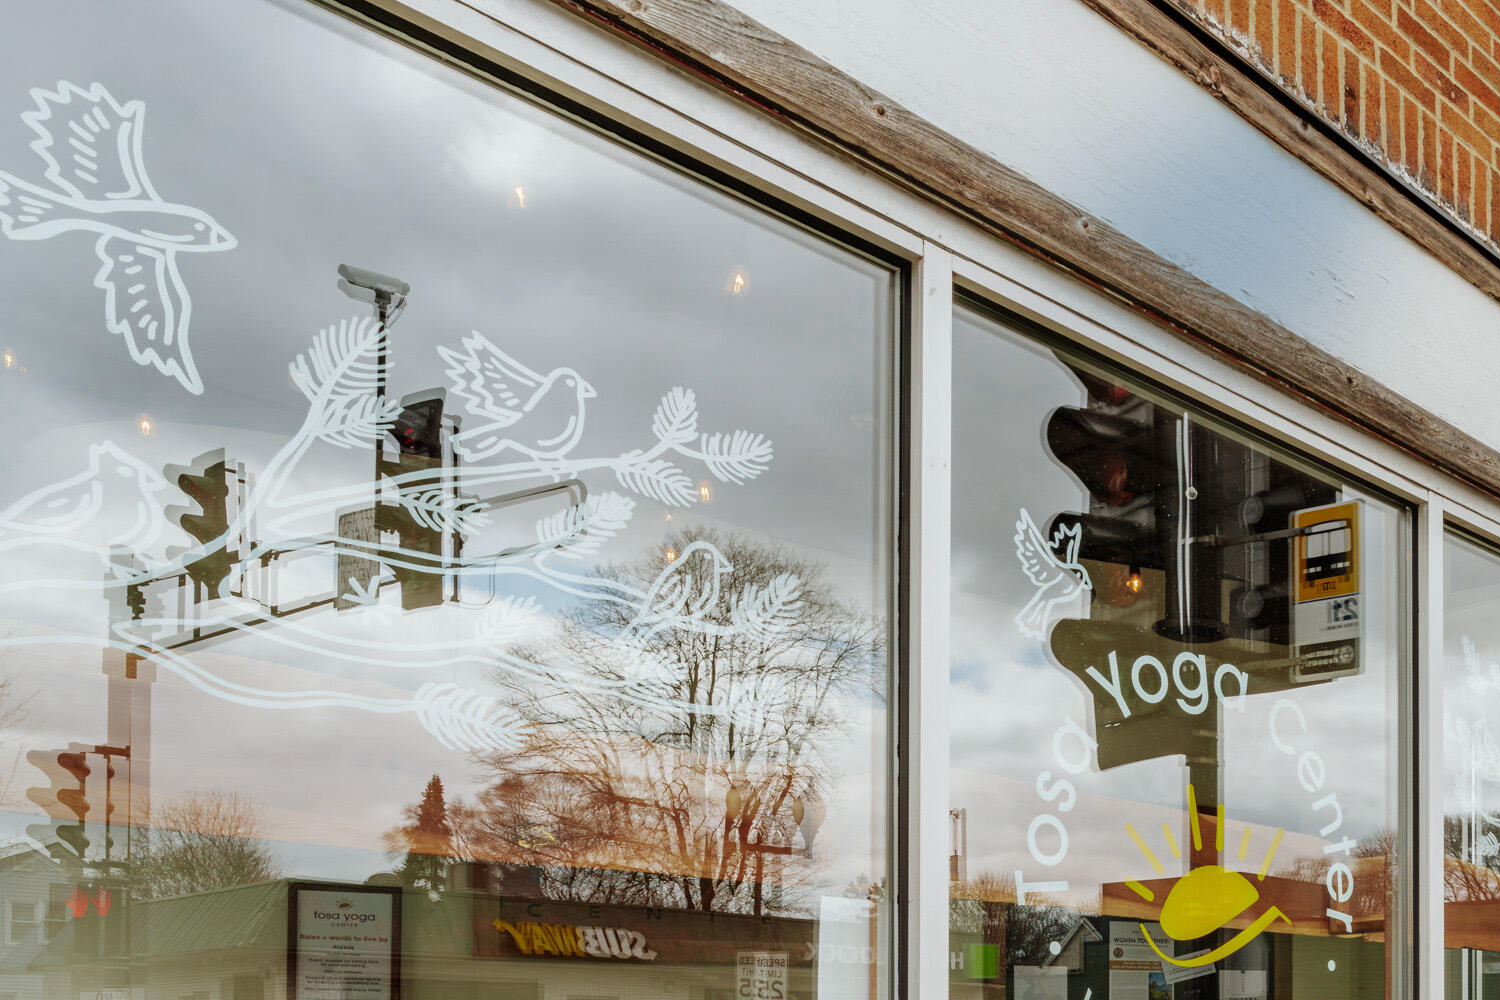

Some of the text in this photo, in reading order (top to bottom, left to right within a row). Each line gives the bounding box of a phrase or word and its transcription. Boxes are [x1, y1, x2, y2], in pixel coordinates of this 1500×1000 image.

[1014, 650, 1357, 934] Tosa Yoga Center
[313, 911, 376, 923] tosa yoga
[1113, 937, 1137, 945] WOVEN
